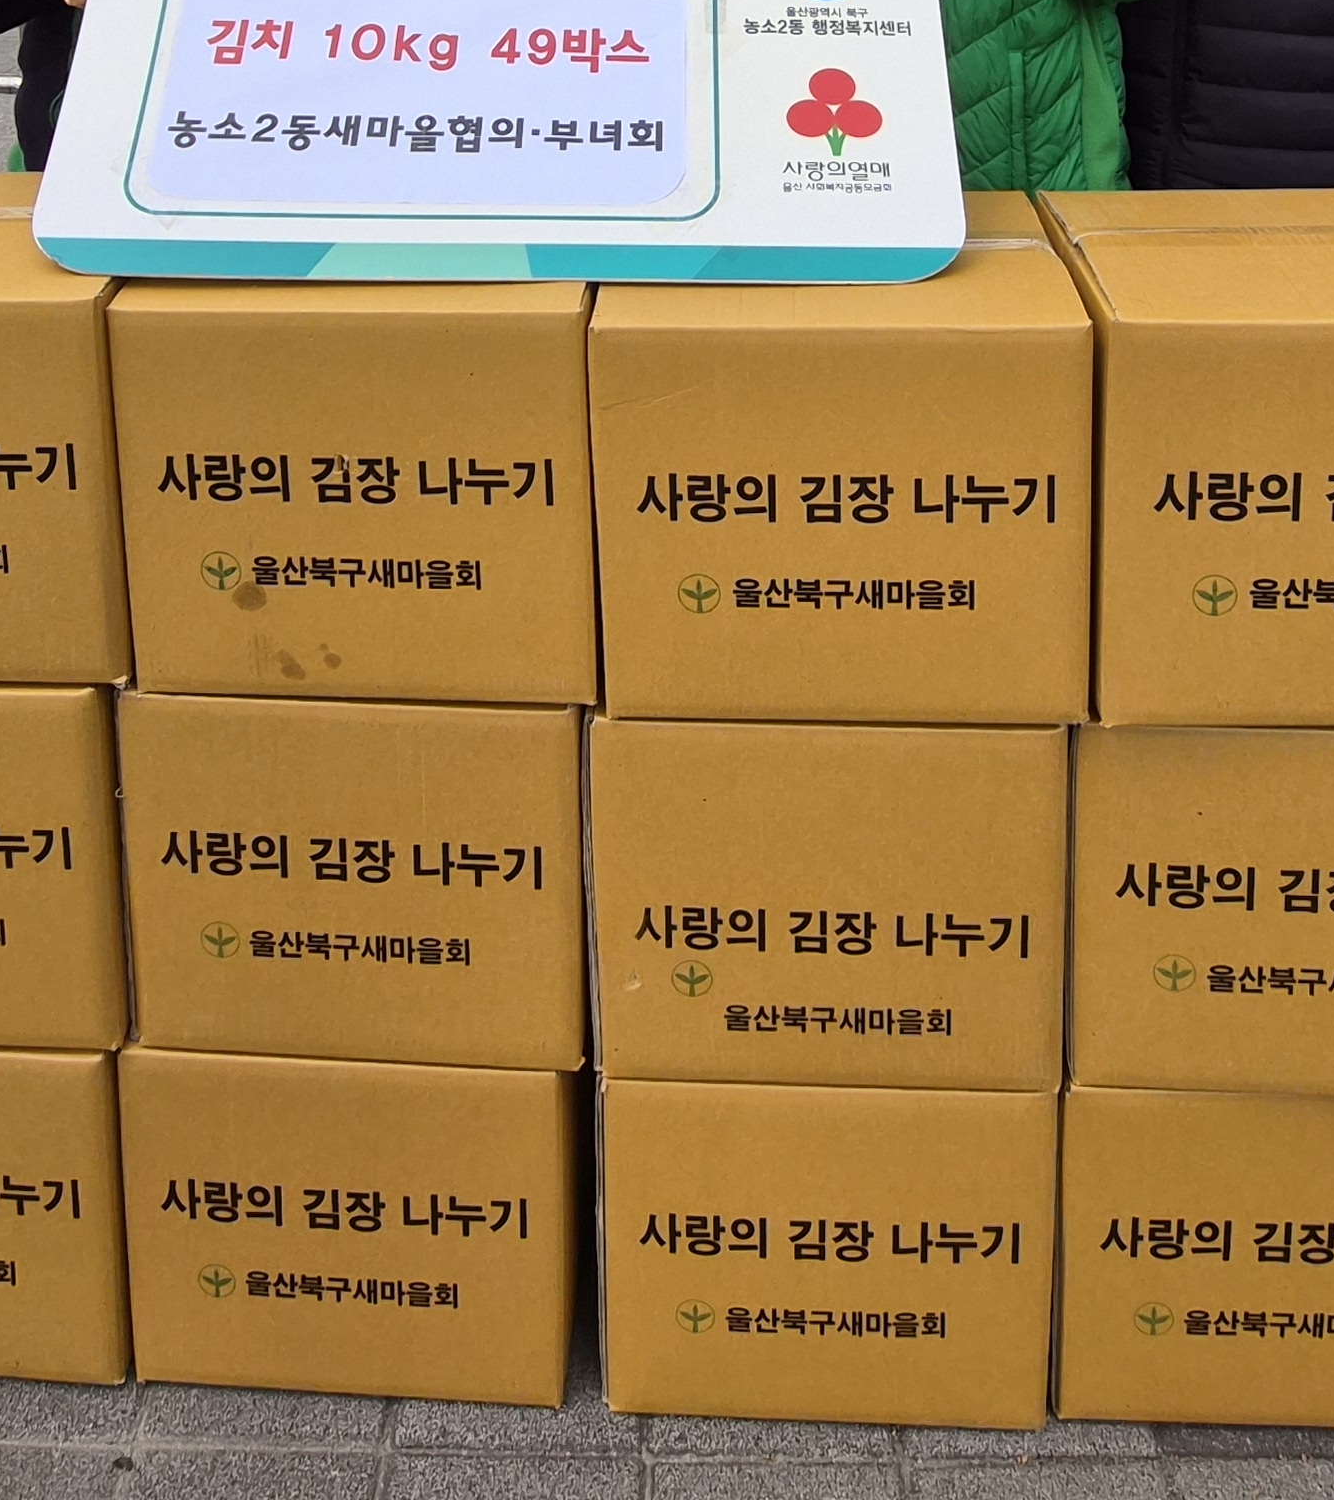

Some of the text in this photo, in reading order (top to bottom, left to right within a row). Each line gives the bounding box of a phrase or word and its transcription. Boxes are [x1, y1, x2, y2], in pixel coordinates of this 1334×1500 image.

[743, 18, 912, 36] 농소2동 행정복지센터
[786, 6, 869, 18] 울산광역시 북구
[206, 18, 650, 73] 김치 10kg 49박스
[782, 161, 891, 181] 사랑의열매
[157, 453, 554, 507] 사랑의 김장 나누기
[636, 472, 1056, 524] 사랑의 김장 나누기
[1153, 470, 1302, 522] 사랑의
[251, 555, 482, 591] 울산북구새마을회
[732, 578, 975, 611] 울산북구새마을회
[160, 830, 542, 891] 사랑의 김장 나누기
[1115, 862, 1256, 912] 사랑의
[249, 930, 471, 967] 울산북구새마을회
[634, 905, 1029, 959] 사랑의 김장 나누기
[723, 1004, 952, 1037] 울산북구새마을회
[160, 1178, 528, 1240] 사랑의 김장 나누기
[639, 1212, 1020, 1265] 사랑의 김장 나누기
[1099, 1216, 1232, 1262] 사랑의
[245, 1270, 459, 1309] 울산북구새마을회
[725, 1307, 946, 1339] 울산북구새마을회
